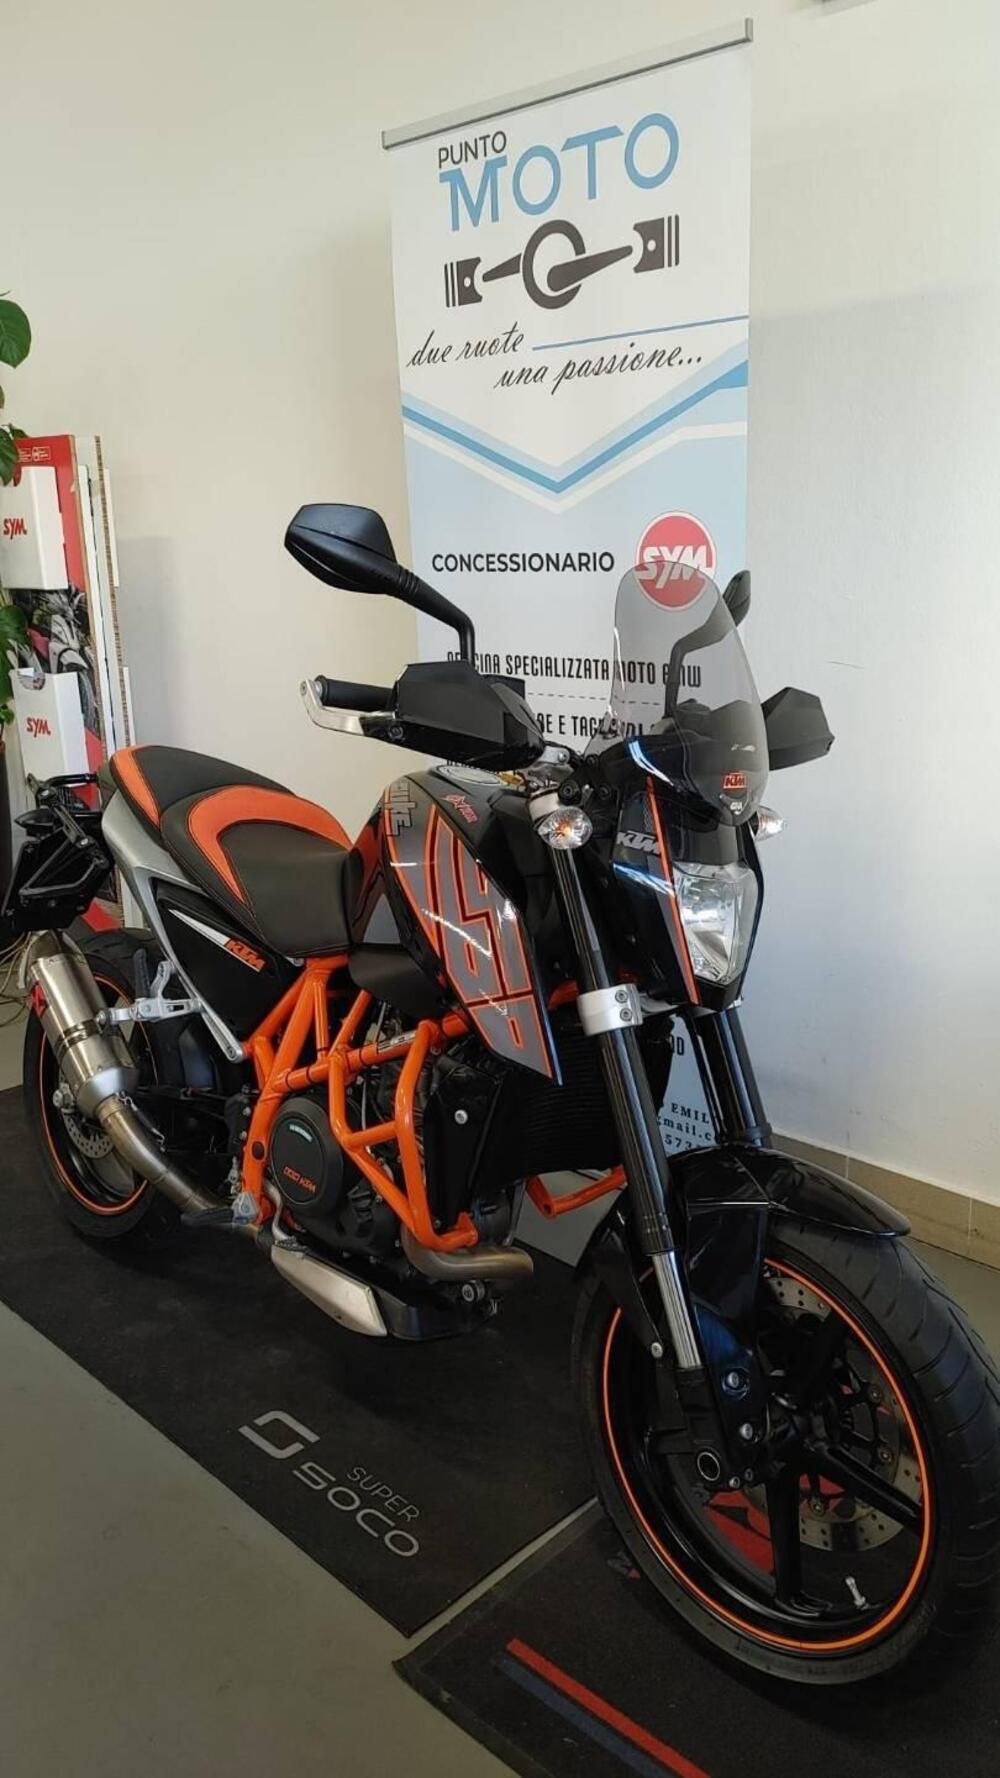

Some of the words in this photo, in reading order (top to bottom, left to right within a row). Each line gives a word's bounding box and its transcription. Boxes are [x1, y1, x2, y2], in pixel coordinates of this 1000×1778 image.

[438, 130, 507, 168] PUNTO
[439, 113, 680, 231] MOTO
[406, 329, 452, 367] due
[456, 321, 524, 360] ruote
[493, 365, 548, 389] una
[552, 342, 702, 395] passione...
[3, 517, 27, 540] SYM
[432, 551, 615, 573] CONCESSIONARIO
[634, 545, 714, 589] SYM
[505, 654, 609, 681] SPECIALIZZATA
[26, 716, 51, 738] SYM
[558, 715, 566, 735] E
[616, 830, 662, 855] KTM
[225, 939, 265, 971] KTM
[292, 1461, 420, 1557] SOCO
[347, 1466, 420, 1522] SUPER
